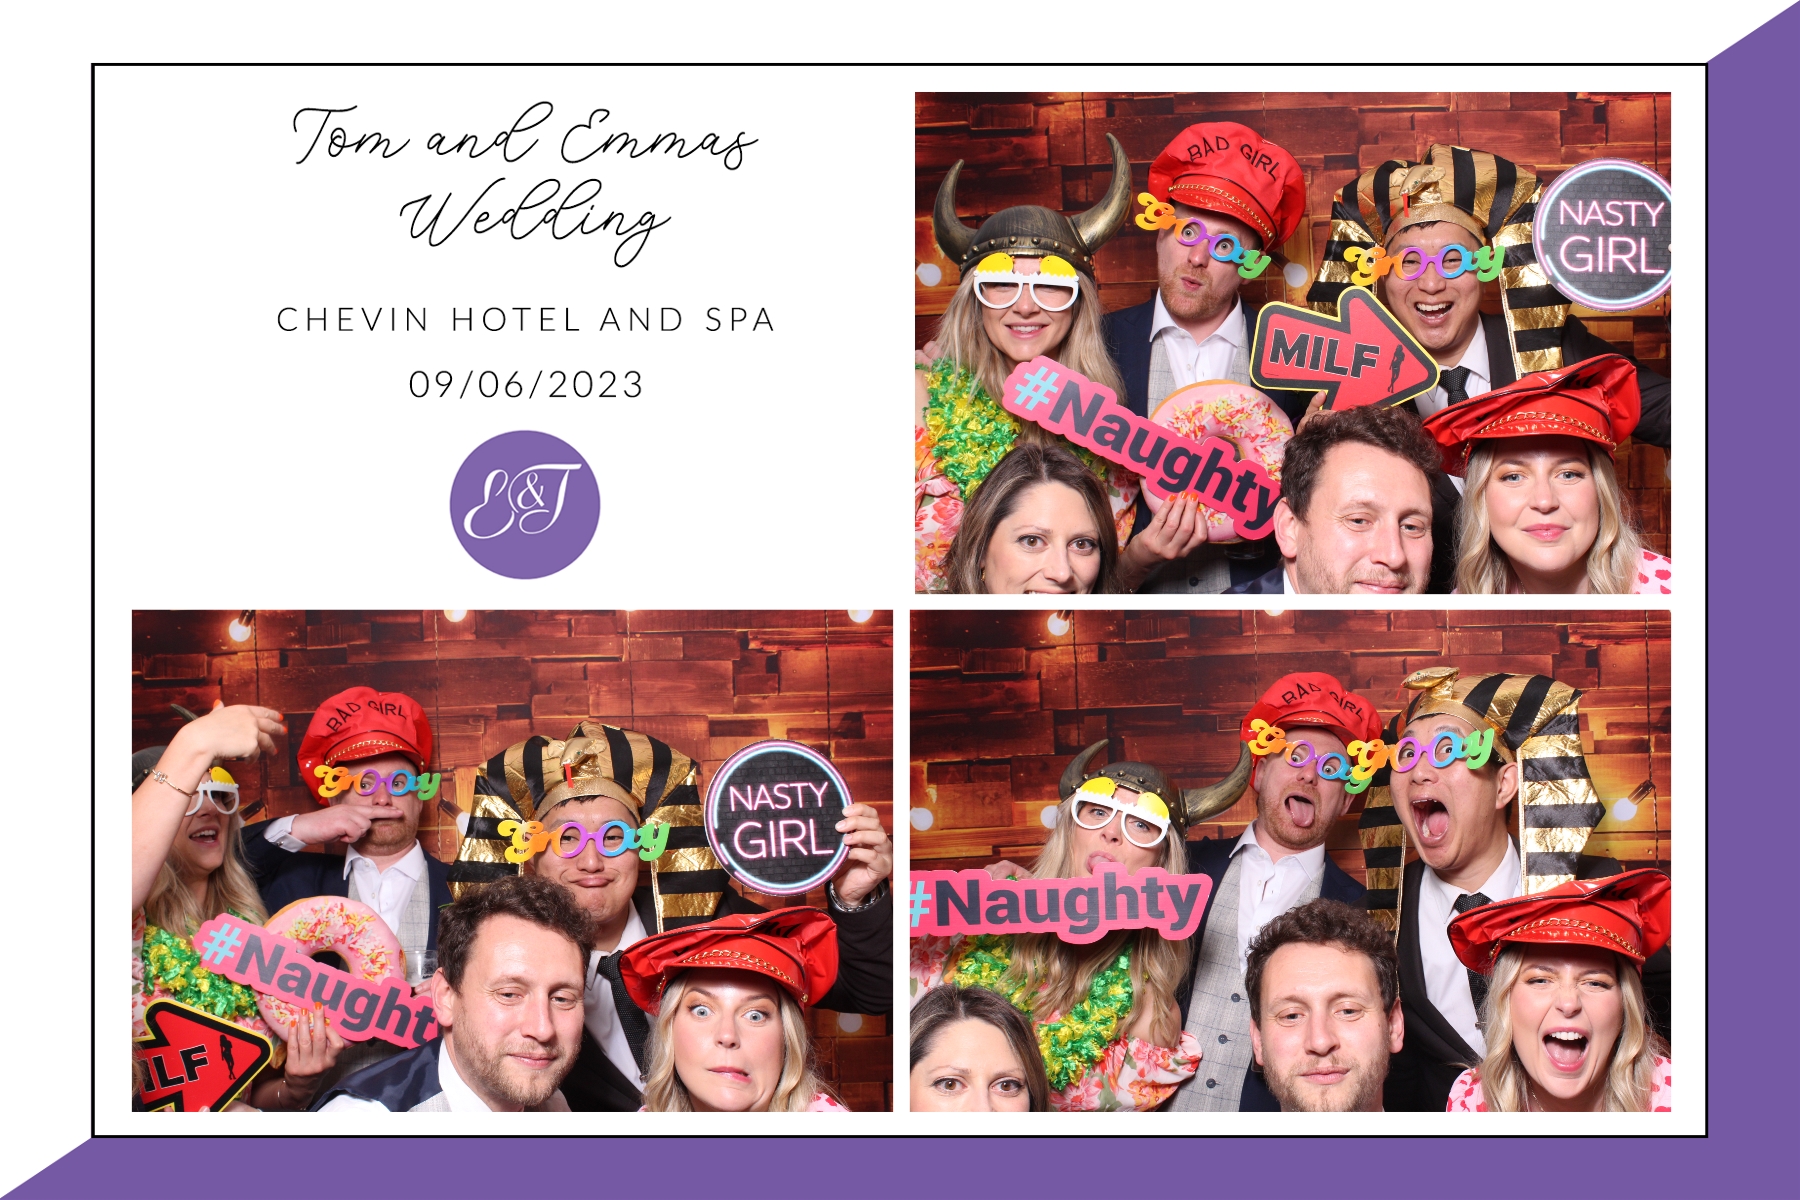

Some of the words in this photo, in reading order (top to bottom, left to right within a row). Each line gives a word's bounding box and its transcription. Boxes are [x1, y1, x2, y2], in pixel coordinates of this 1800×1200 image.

[1187, 135, 1231, 163] BAD
[1240, 142, 1281, 182] GIRL
[1559, 199, 1665, 228] NASTY
[1559, 235, 1666, 275] GIRL
[1268, 327, 1382, 380] MILF
[1014, 364, 1280, 531] #Naughty
[326, 702, 362, 732] BAD
[367, 699, 408, 721] GIRL
[729, 781, 829, 812] NASTY
[733, 817, 835, 859] GIRL
[910, 871, 1202, 935] #Naughty
[201, 922, 436, 1046] #Naught
[140, 1043, 210, 1093] ILF
